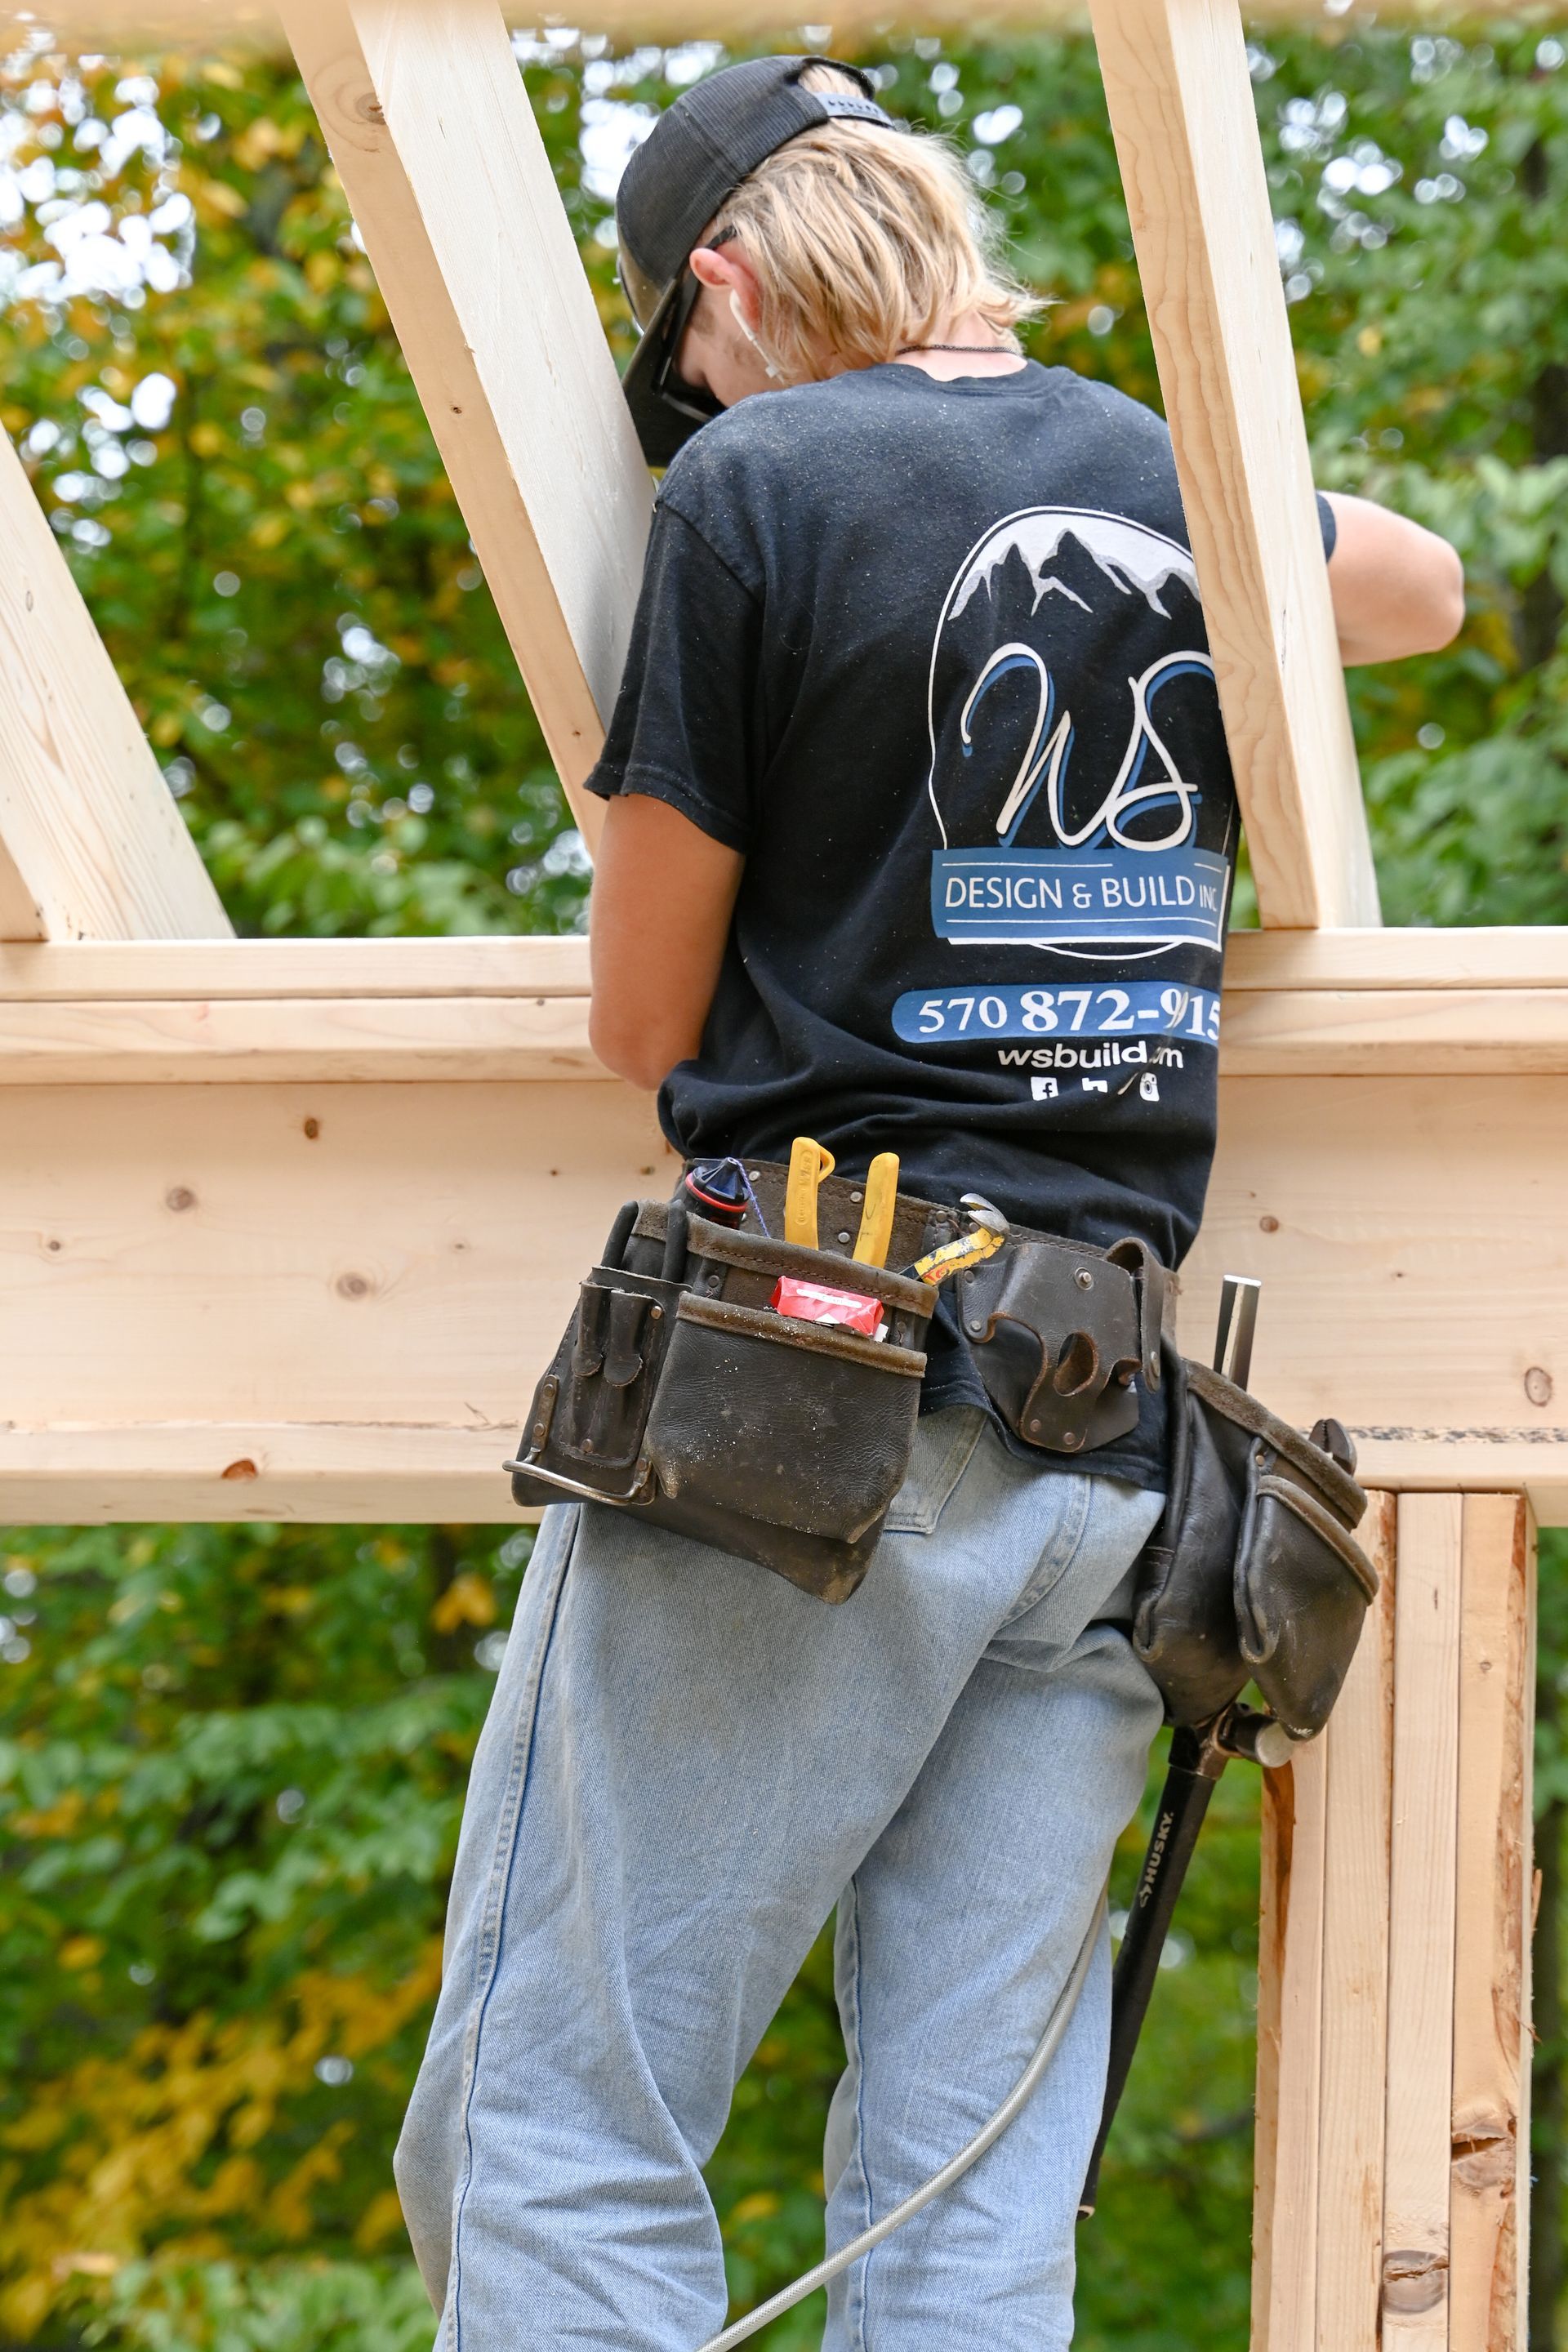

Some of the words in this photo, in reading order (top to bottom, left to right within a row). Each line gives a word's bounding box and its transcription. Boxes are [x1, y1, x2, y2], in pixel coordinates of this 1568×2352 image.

[945, 877, 1062, 909] DESIGN
[1072, 883, 1092, 909] &
[1101, 875, 1195, 906] BUILD
[1199, 884, 1218, 911] INC
[919, 996, 1009, 1033] 570
